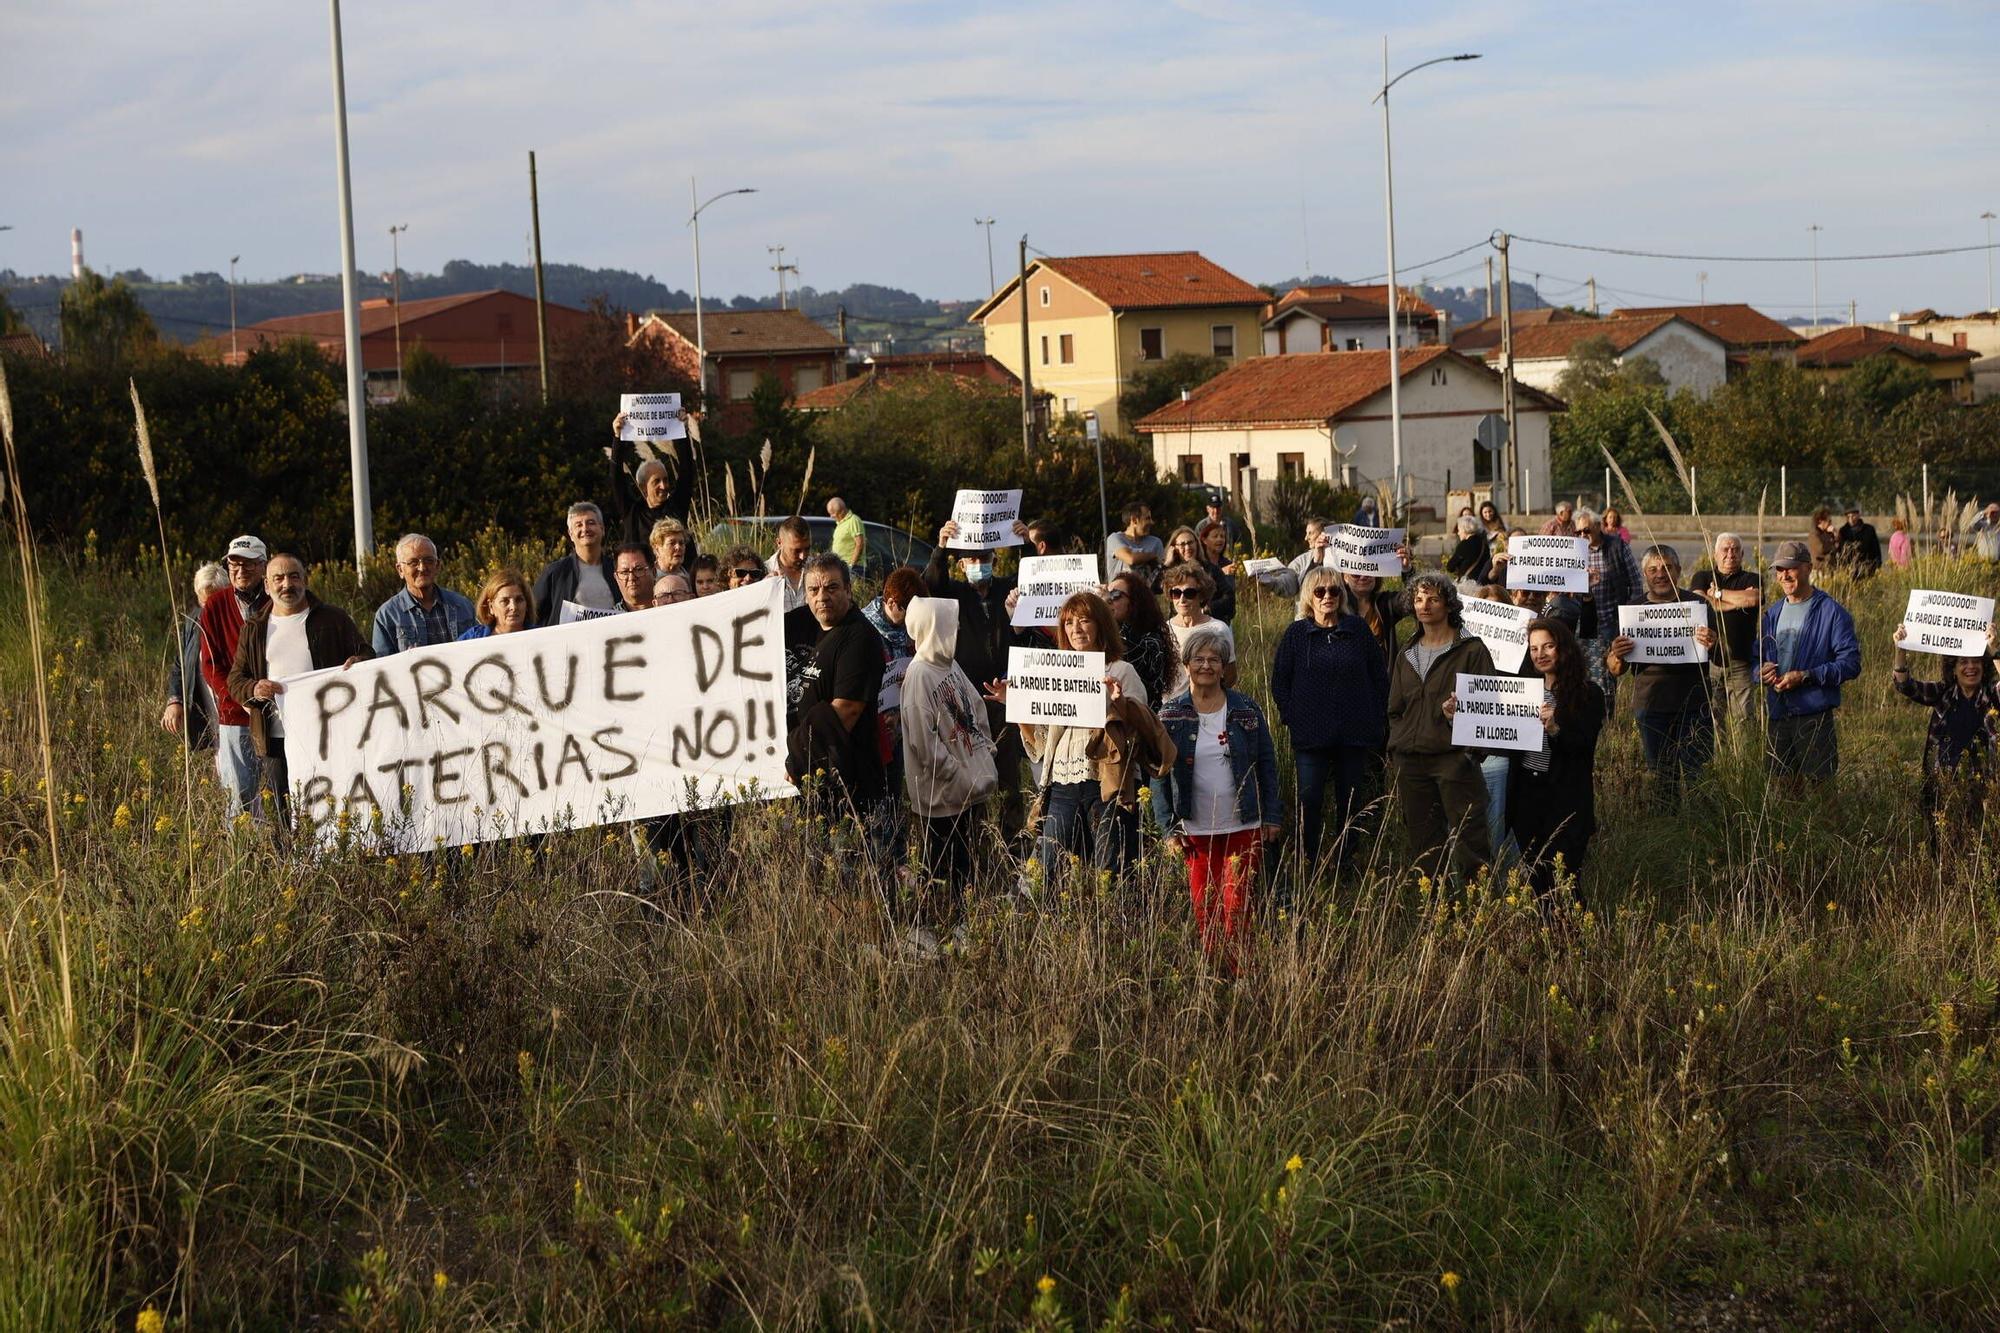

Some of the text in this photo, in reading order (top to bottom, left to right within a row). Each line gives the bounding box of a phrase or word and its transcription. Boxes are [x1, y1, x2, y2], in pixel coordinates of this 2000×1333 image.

[651, 411, 658, 420] DE
[637, 426, 668, 436] EN LLOREDA
[981, 512, 989, 524] DE
[973, 530, 1001, 543] LLOREDA
[1333, 538, 1358, 555] PARQUE
[1358, 545, 1368, 557] DE
[1340, 558, 1379, 572] EN LLOREDA
[1509, 555, 1518, 566] AL
[1519, 556, 1544, 567] PARQUE
[1545, 557, 1554, 567] DE
[1527, 574, 1566, 586] EN LLOREDA
[1028, 582, 1053, 597] PARQUE
[1054, 582, 1063, 596] DE
[1034, 606, 1044, 619] EN
[1906, 611, 1913, 623] AL
[1914, 612, 1941, 626] PARQUE
[1942, 616, 1952, 628] DE
[1483, 624, 1494, 638] DE
[1627, 627, 1635, 638] AL
[1636, 627, 1661, 638] PARQUE
[1663, 627, 1672, 638] DE
[1921, 633, 1963, 649] EN LLOREDA
[1646, 645, 1685, 657] EN LLOREDA
[314, 608, 773, 762] PARQUE DE
[1008, 675, 1018, 689] AL
[1020, 676, 1050, 691] PARQUE
[1051, 678, 1062, 692] DE
[1031, 701, 1078, 717] EN LLOREDA
[1456, 700, 1465, 713] AL
[1466, 700, 1494, 715] PARQUE
[1495, 702, 1505, 716] DE
[671, 698, 777, 768] NO!!
[1475, 725, 1518, 741] EN LLOREDA
